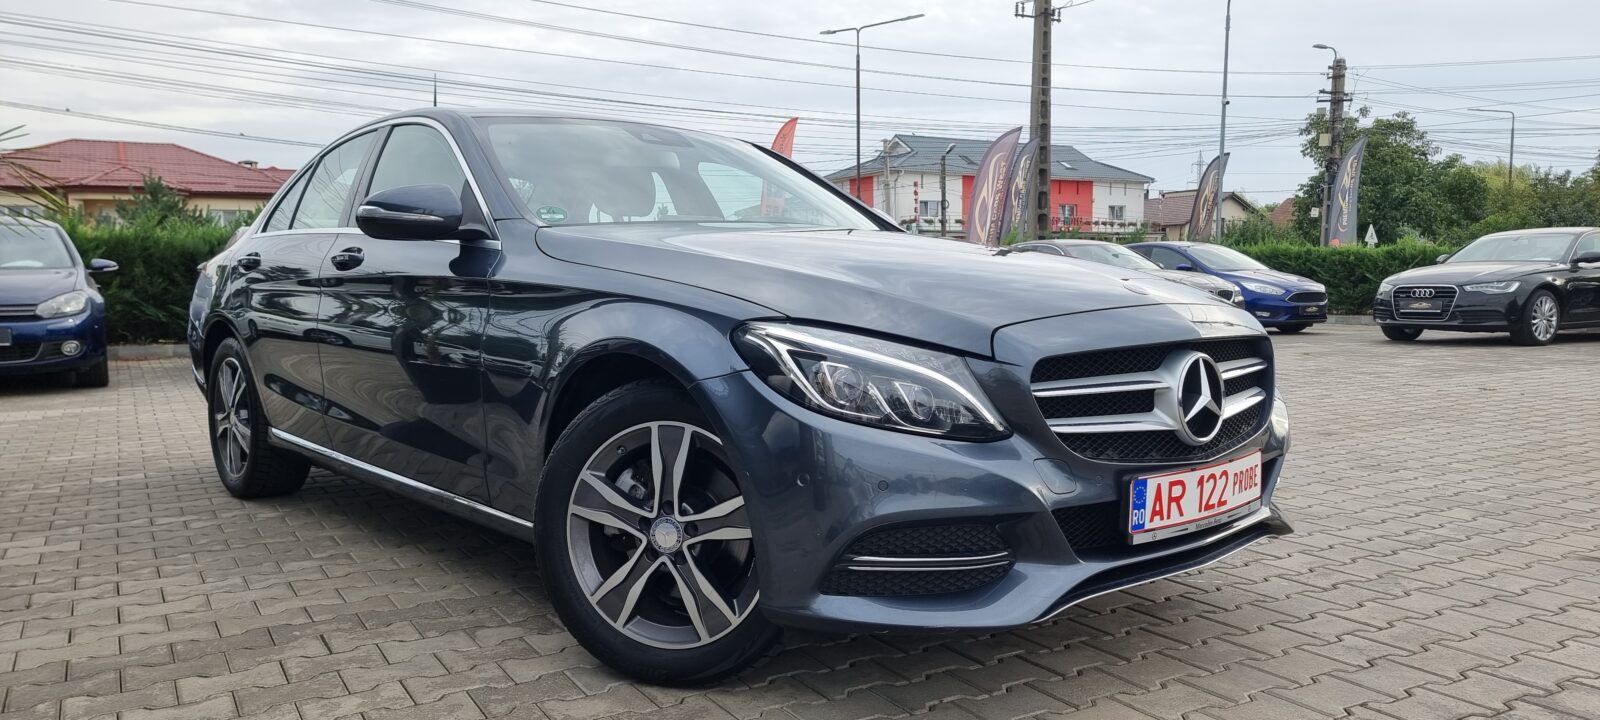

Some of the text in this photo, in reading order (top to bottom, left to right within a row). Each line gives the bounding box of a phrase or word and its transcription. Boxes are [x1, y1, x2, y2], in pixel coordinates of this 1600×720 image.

[1149, 464, 1259, 523] AR 122 PROBE
[1132, 509, 1145, 526] RO
